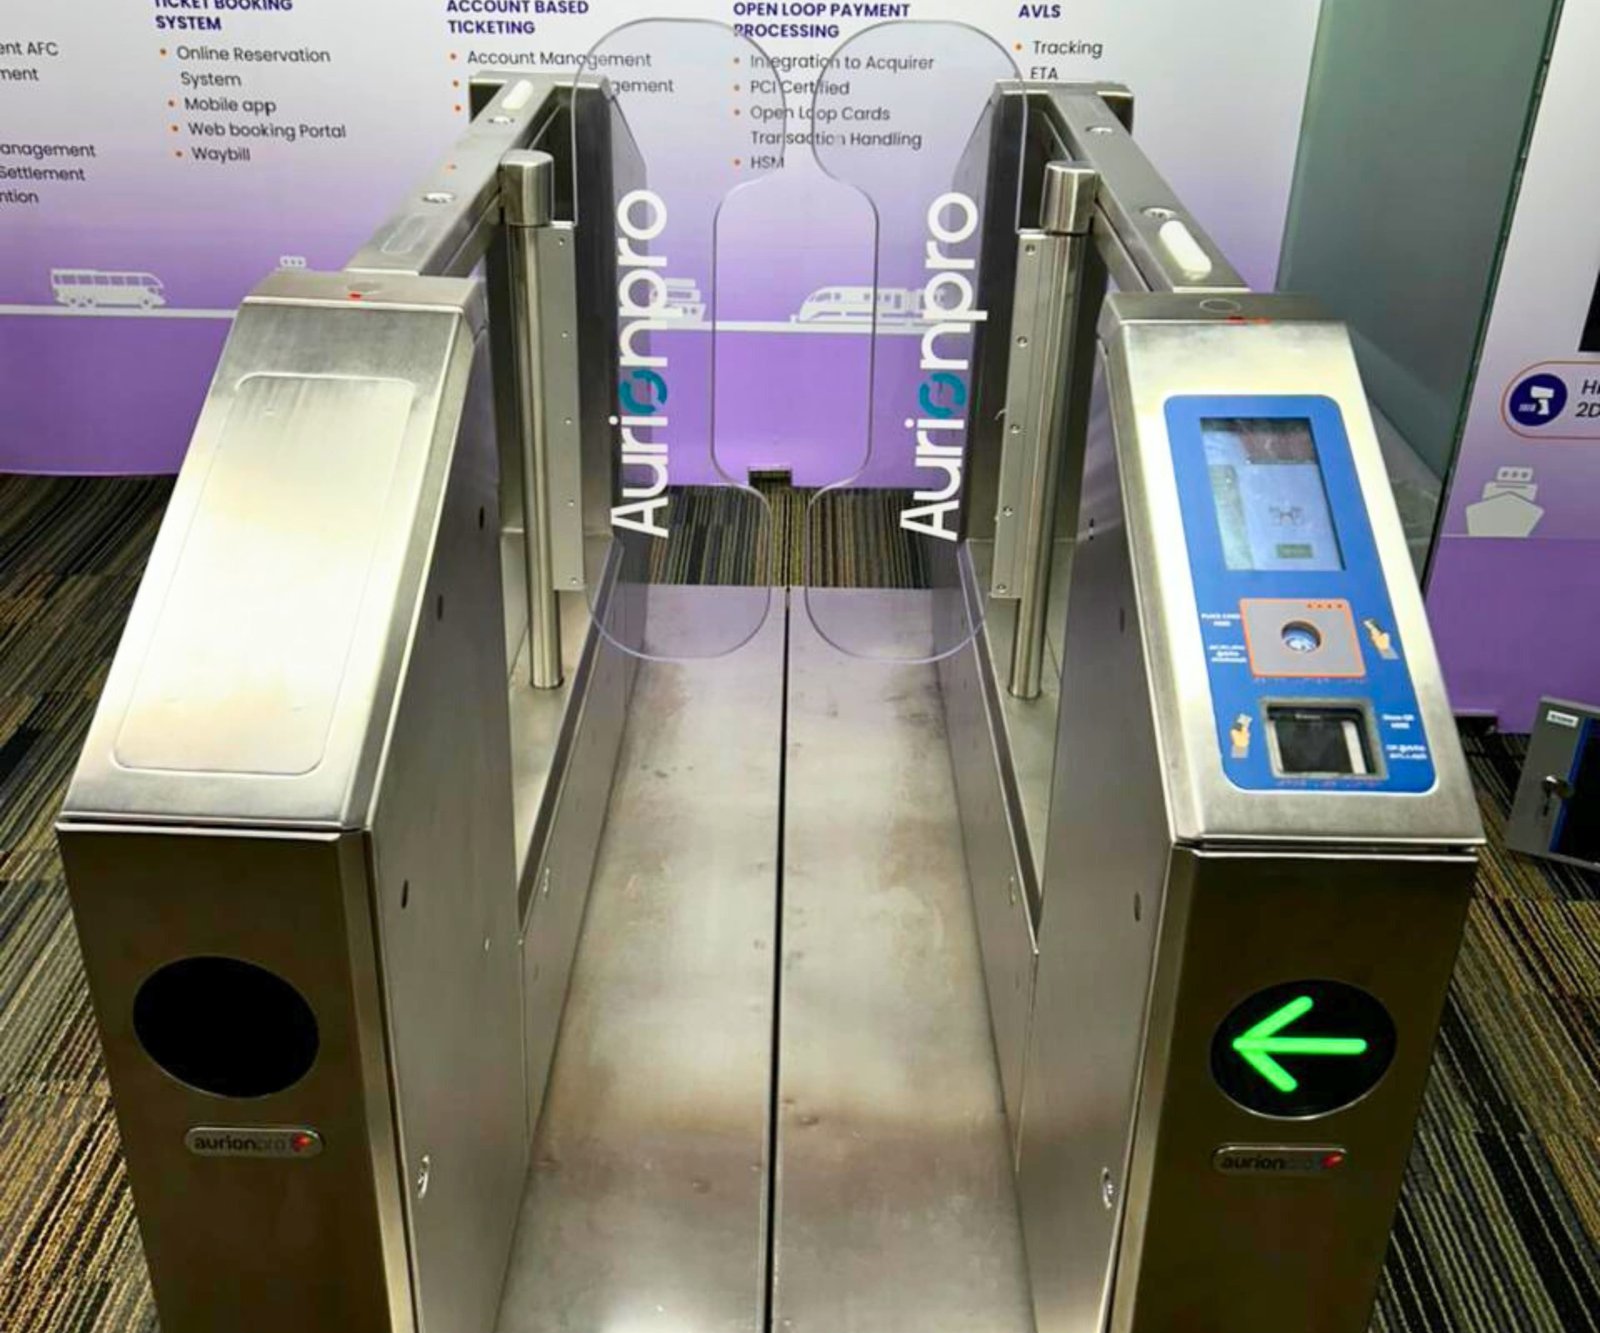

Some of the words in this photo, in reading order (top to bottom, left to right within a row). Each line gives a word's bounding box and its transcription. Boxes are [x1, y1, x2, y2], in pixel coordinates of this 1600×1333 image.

[214, 0, 292, 10] BOOKING
[446, 0, 529, 12] ACCOUNT
[534, 0, 588, 13] BASED
[733, 2, 778, 16] OPEN
[782, 2, 827, 16] LOOP
[831, 2, 910, 17] PAYMENT
[1018, 3, 1060, 18] AVLS
[155, 15, 221, 30] SYSTEM
[448, 20, 535, 34] TICKETING
[733, 23, 839, 38] PROCESSING
[27, 42, 59, 56] AFC
[176, 46, 229, 61] Online
[233, 47, 330, 62] Reservation
[1033, 40, 1103, 58] Tracking
[467, 50, 535, 64] Account
[540, 50, 651, 70] Management
[844, 60, 861, 70] to
[865, 54, 934, 72] Acquirer
[180, 70, 241, 86] System
[1030, 66, 1059, 80] ETA
[750, 79, 776, 93] PCI
[781, 79, 850, 95] Certfied
[184, 97, 238, 111] Mobile
[242, 100, 276, 116] app
[750, 104, 794, 123] Open
[799, 105, 837, 124] Loop
[841, 106, 890, 120] Cards
[187, 122, 225, 136] Web
[229, 122, 295, 141] booking
[299, 124, 346, 138] Portal
[849, 131, 922, 151] Handling
[191, 146, 250, 163] Waybill
[750, 155, 784, 168] HSM
[609, 190, 684, 539] Aurionpro
[900, 192, 988, 541] Aurionpro
[1581, 379, 1600, 395] H
